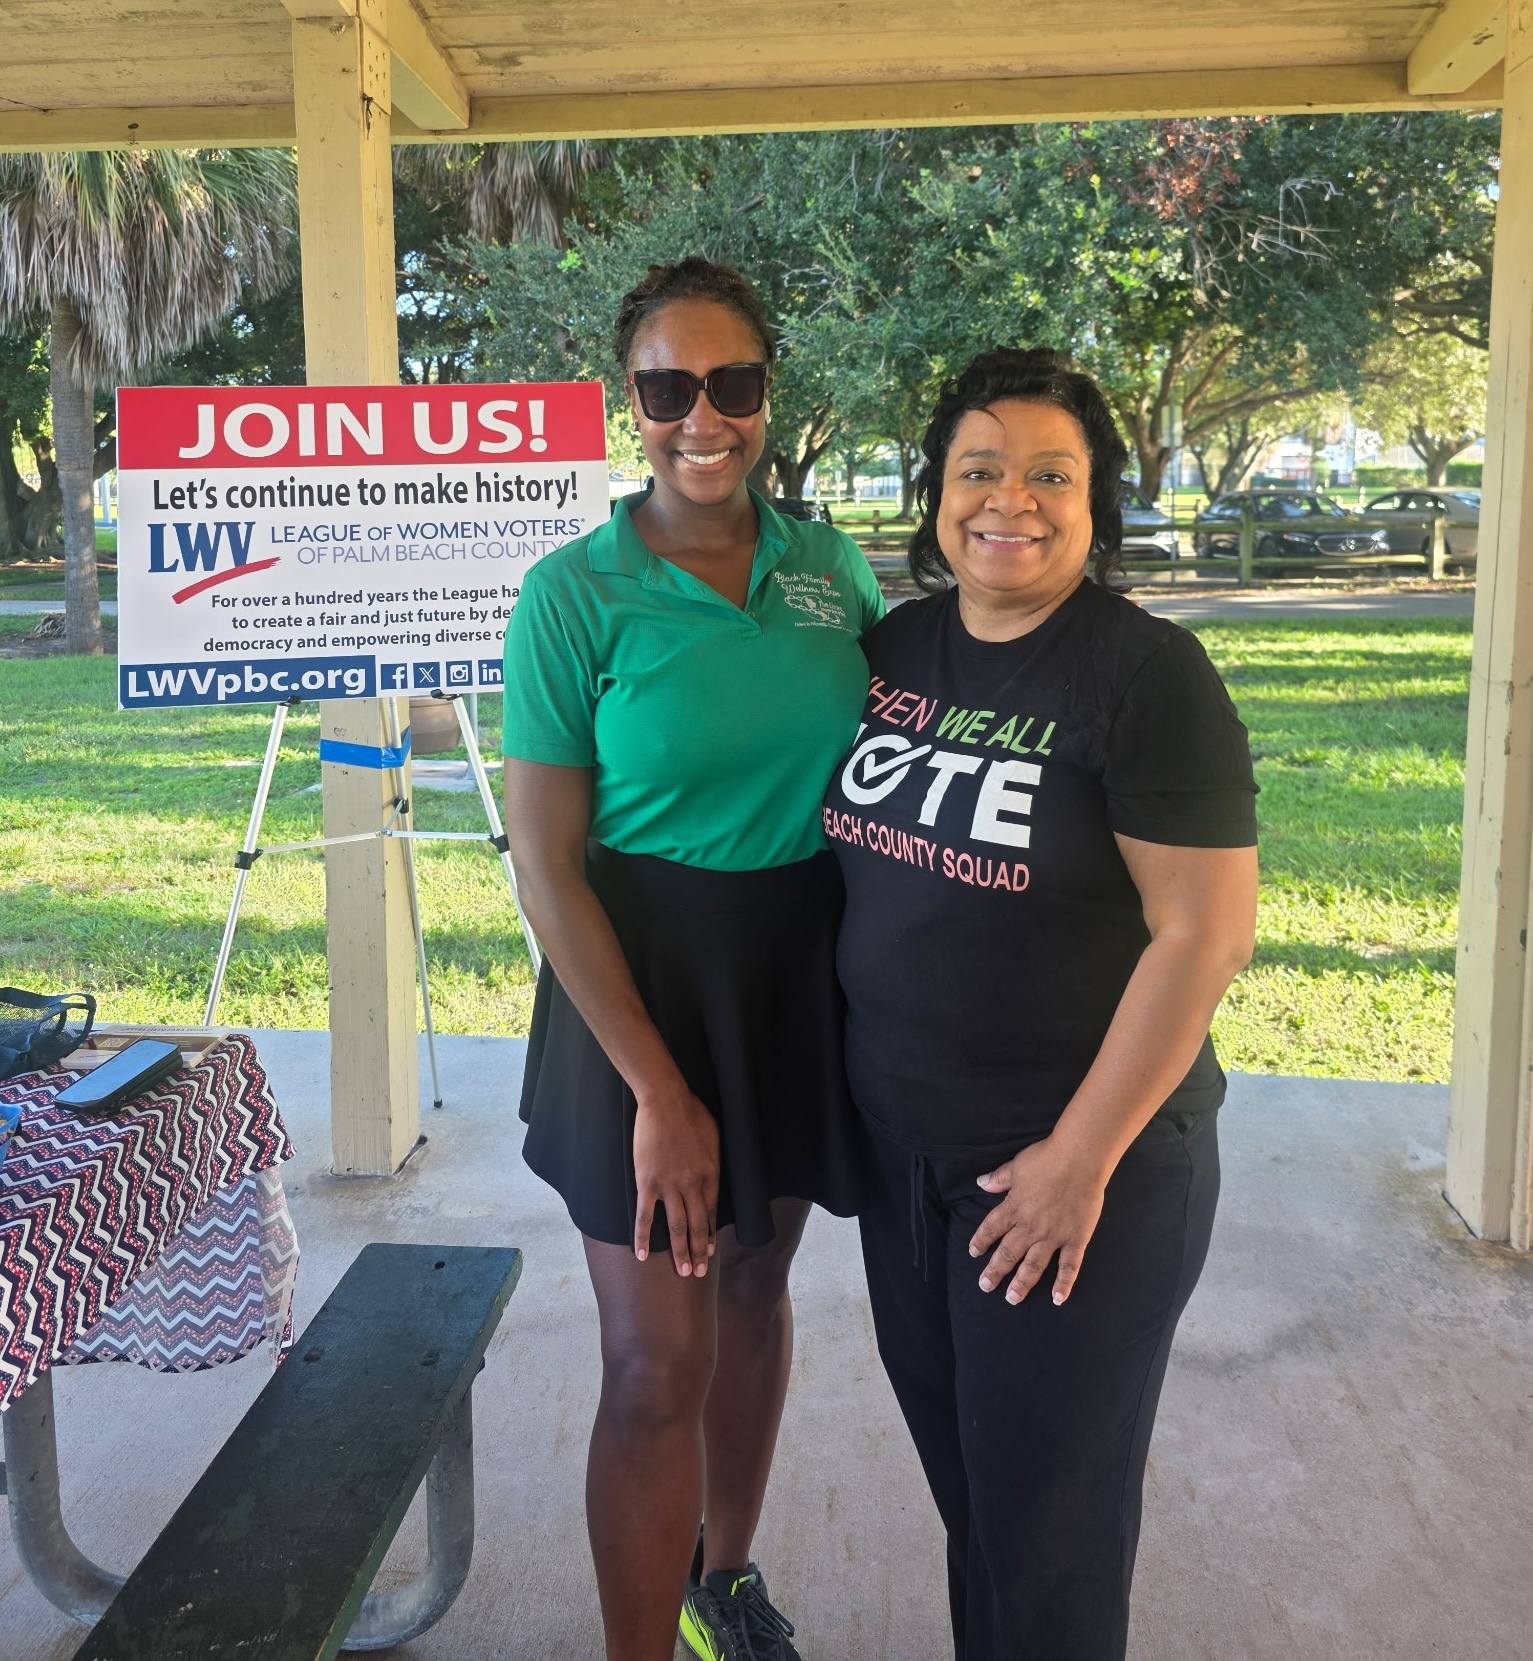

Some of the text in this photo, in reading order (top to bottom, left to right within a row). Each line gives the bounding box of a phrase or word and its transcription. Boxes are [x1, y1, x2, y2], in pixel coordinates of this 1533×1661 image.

[178, 400, 548, 458] JOIN US!
[153, 471, 578, 509] Let's continue to make history!
[148, 521, 256, 573] LWV
[271, 524, 362, 544] LEAGUE
[367, 526, 393, 541] OF
[397, 521, 489, 540] WOMEN
[297, 546, 328, 564] OF
[333, 544, 390, 563] PALM
[395, 542, 466, 561] BEACH
[774, 572, 830, 587] Black Family
[781, 583, 821, 594] Wellness
[211, 584, 520, 608] For over a hundred years the League ha
[232, 616, 249, 629] to
[253, 615, 302, 628] create
[307, 616, 315, 627] a
[319, 612, 347, 626] fair
[351, 611, 380, 625] and
[383, 610, 413, 627] just
[417, 607, 465, 623] future
[469, 606, 488, 623] by
[203, 638, 292, 652] democracy
[297, 634, 327, 648] and
[332, 630, 431, 651] empowering
[435, 629, 491, 643] diverse
[128, 665, 366, 701] LWVpbc.org
[869, 675, 1056, 756] HEN WE ALL
[841, 722, 1042, 848] OTE
[866, 821, 937, 872] COUNTY
[942, 847, 1030, 892] SQUAD
